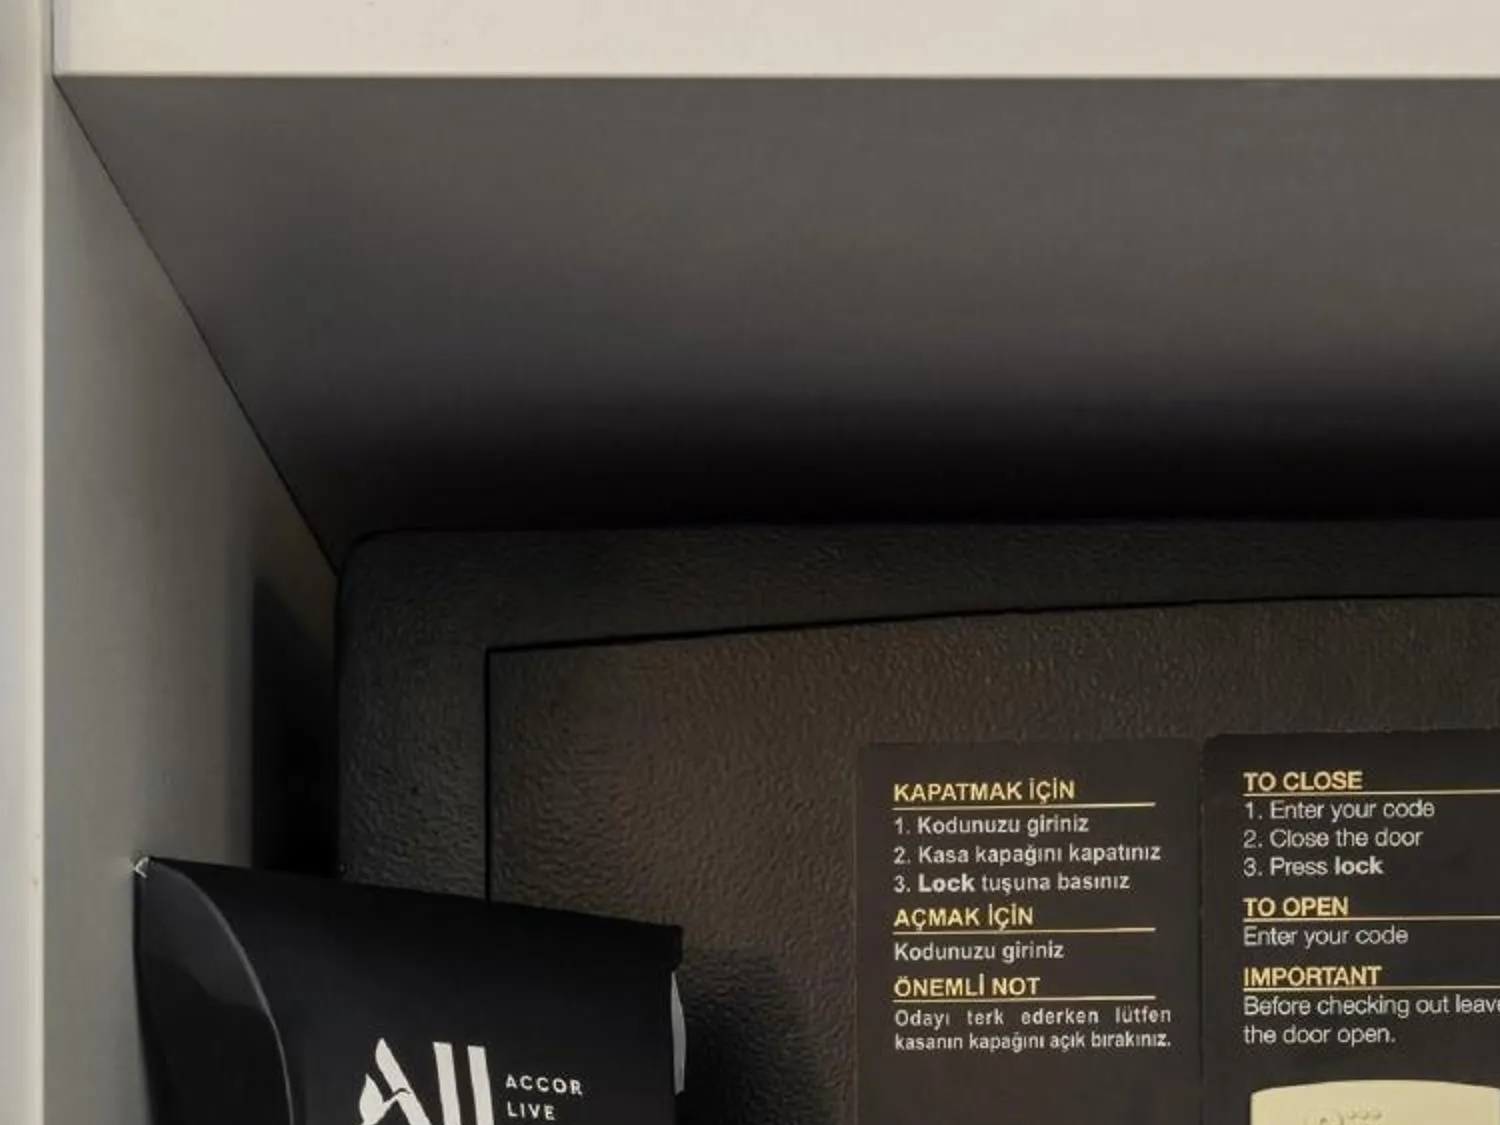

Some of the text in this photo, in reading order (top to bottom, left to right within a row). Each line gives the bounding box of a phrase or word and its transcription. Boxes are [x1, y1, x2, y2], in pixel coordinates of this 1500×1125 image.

[893, 777, 1076, 804] KAPATMAK İÇİN
[1243, 771, 1363, 792] TO CLOSE
[1245, 799, 1435, 822] 1. Enter your code
[894, 814, 1090, 837] 1. Kodunuzu giriniz
[1243, 828, 1424, 848] 2. Close the door
[893, 844, 1162, 866] 2. Kasa kapağını kapatınız
[1243, 856, 1384, 877] 3. Press lock
[893, 872, 1131, 896] 3. Lock tuşuna basınız
[893, 904, 1034, 930] AÇMAK İÇİN
[1243, 897, 1349, 917] TO OPEN
[1243, 926, 1409, 949] Enter your code
[893, 940, 1065, 963] Kodunuzu giriniz
[893, 974, 1040, 997] ÖNEMLİ NOT
[1243, 966, 1382, 986] IMPORTANT
[894, 1006, 1172, 1030] Odayı terk ederken lütfen
[1243, 996, 1311, 1016] Before
[1317, 995, 1409, 1019] checking
[1415, 996, 1450, 1014] out
[894, 1031, 1171, 1053] kasanın kapağını açık bırakınız.
[1243, 1025, 1396, 1047] the door open.
[505, 1074, 584, 1096] ACCOR
[507, 1101, 556, 1122] LIVE
